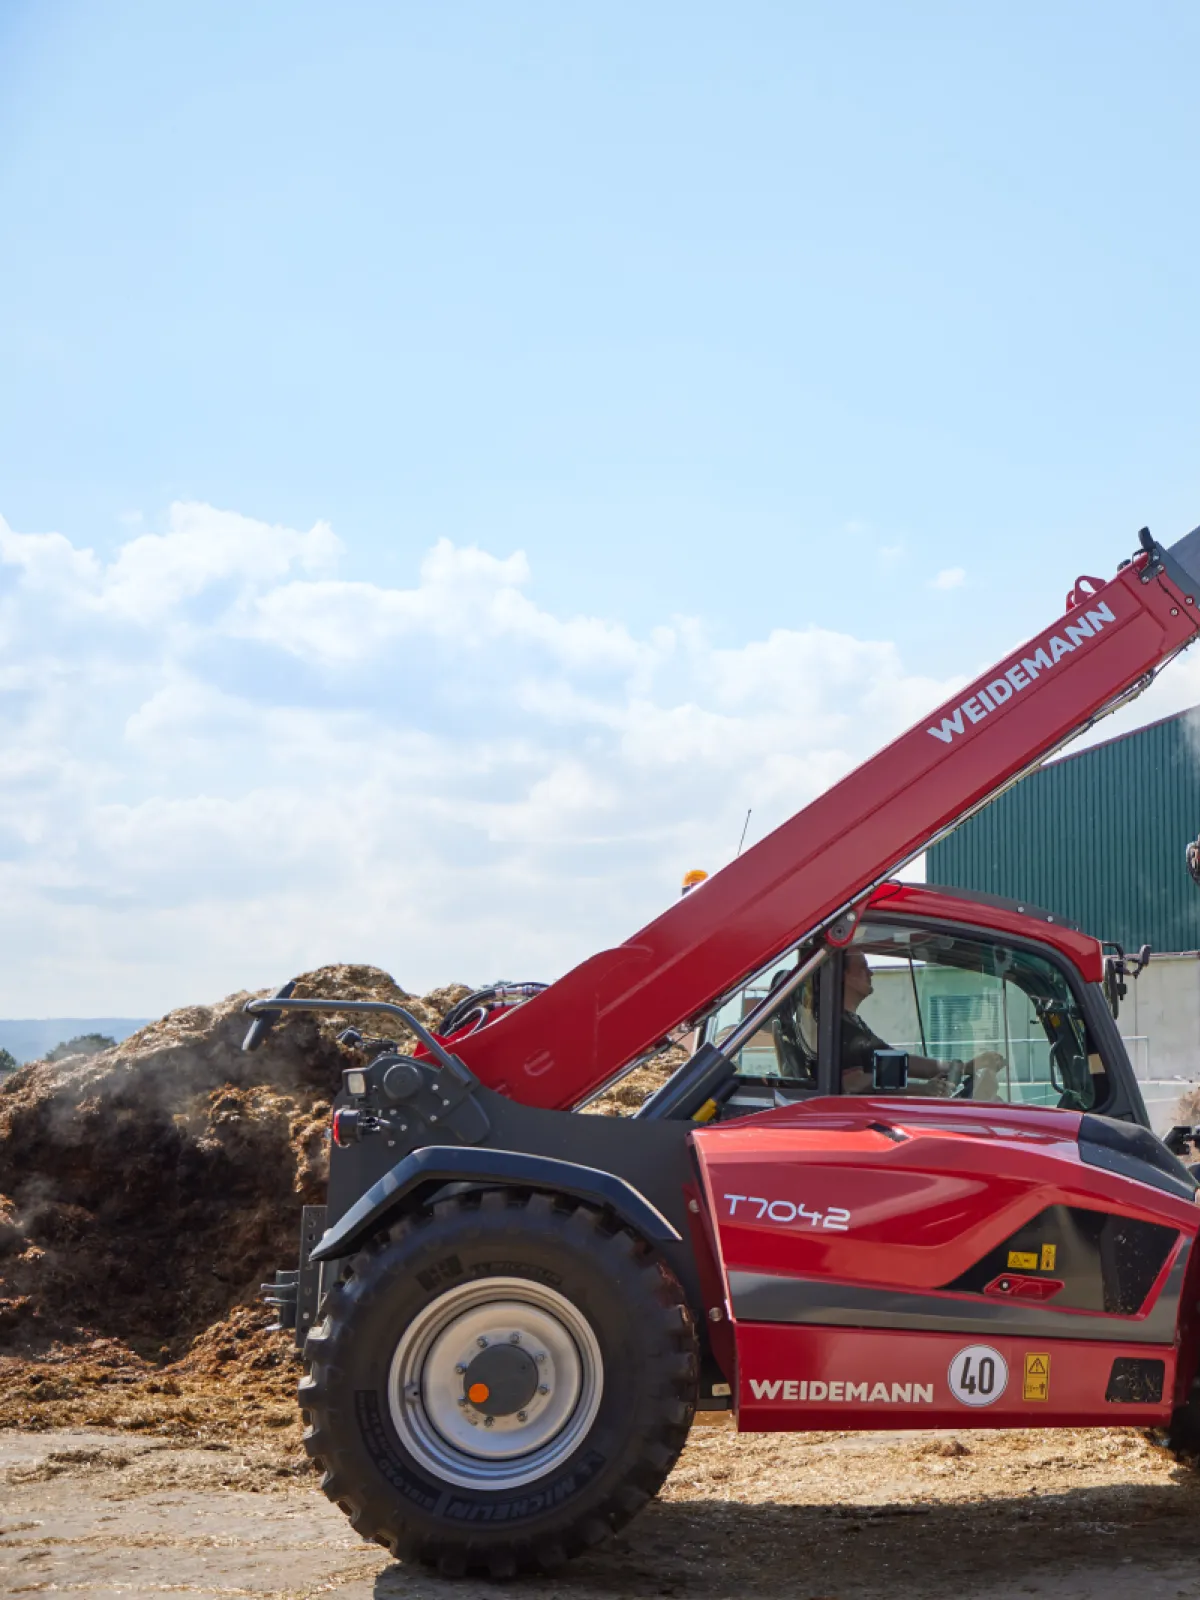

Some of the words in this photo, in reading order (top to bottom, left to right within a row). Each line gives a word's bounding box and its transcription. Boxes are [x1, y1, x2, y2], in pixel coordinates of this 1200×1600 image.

[926, 601, 1116, 744] WEIDEMANN
[723, 1193, 851, 1231] T7042
[749, 1379, 934, 1403] WEIDEMANN
[960, 1356, 996, 1396] 40
